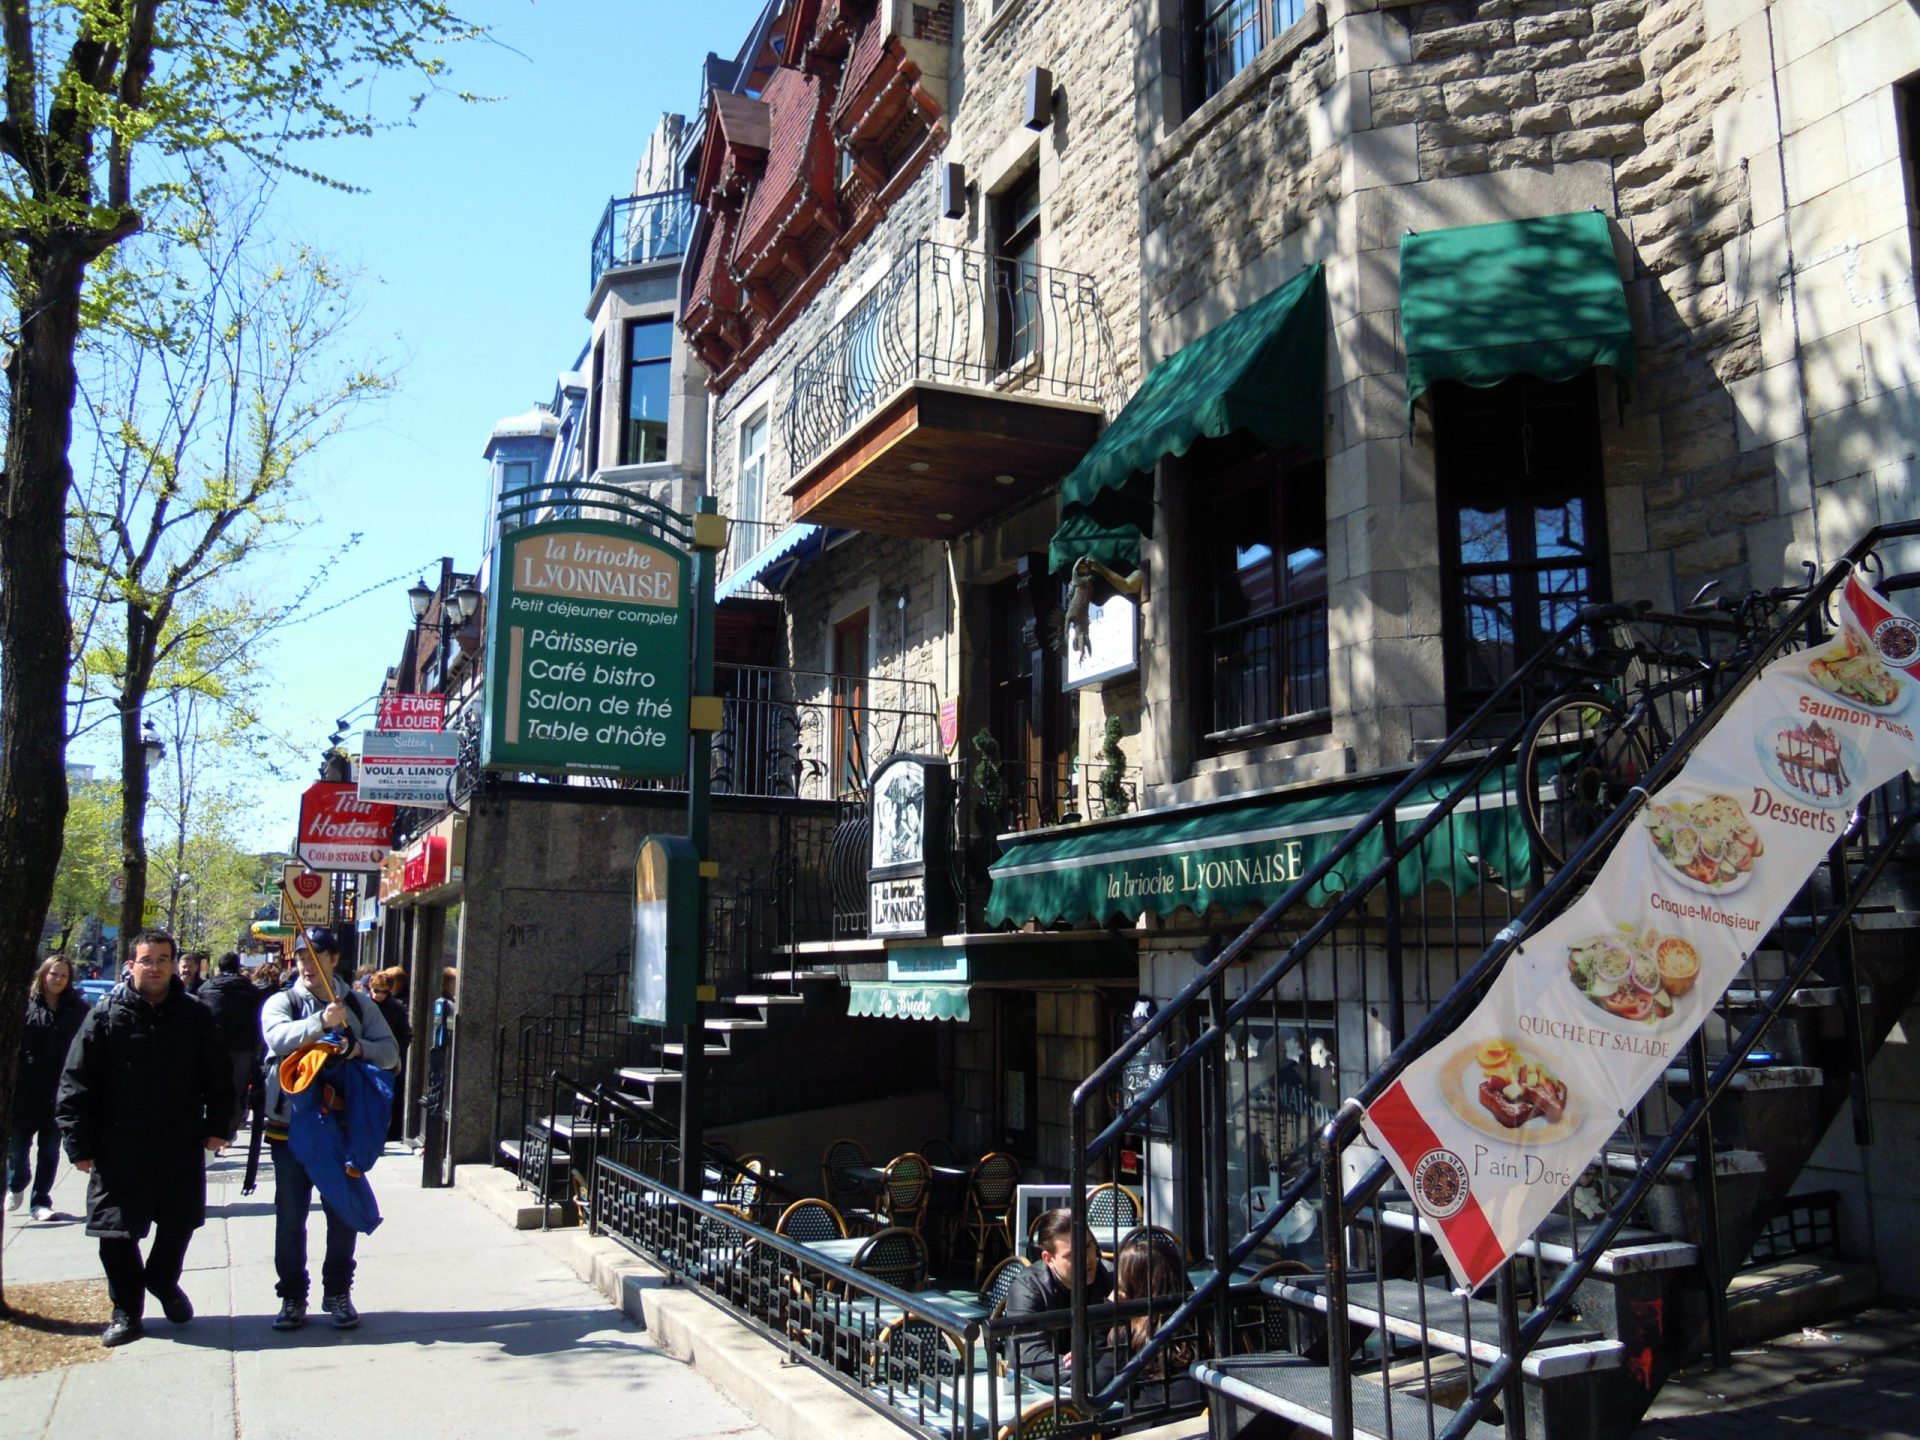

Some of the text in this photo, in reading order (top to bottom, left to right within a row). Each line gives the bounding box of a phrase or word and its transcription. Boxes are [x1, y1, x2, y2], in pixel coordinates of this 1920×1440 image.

[545, 538, 651, 568] la brioche
[523, 557, 673, 601] LYONNAISE
[511, 597, 678, 625] Petit déjeuner complet
[530, 629, 638, 657] Pâtisserie
[529, 659, 656, 688] Café bistro
[527, 689, 673, 718] Salon de thé
[383, 712, 440, 728] À LOUER
[1799, 695, 1914, 742] Saumon Fumé
[528, 719, 667, 747] Table d'hôte
[365, 766, 452, 777] VOULA LIANOS
[334, 790, 373, 815] Tim
[369, 792, 445, 801] 514-272-1010
[1750, 786, 1836, 833] Desserts
[308, 813, 388, 839] Hortons
[308, 848, 369, 863] COLD STONE
[1107, 841, 1305, 898] la brioche LYONNAISE
[293, 899, 322, 910] uliette
[1650, 892, 1761, 932] Croque-Monsieur
[1518, 1015, 1670, 1059] QUICHE ET SALADE
[1474, 1144, 1571, 1187] Pain Doré
